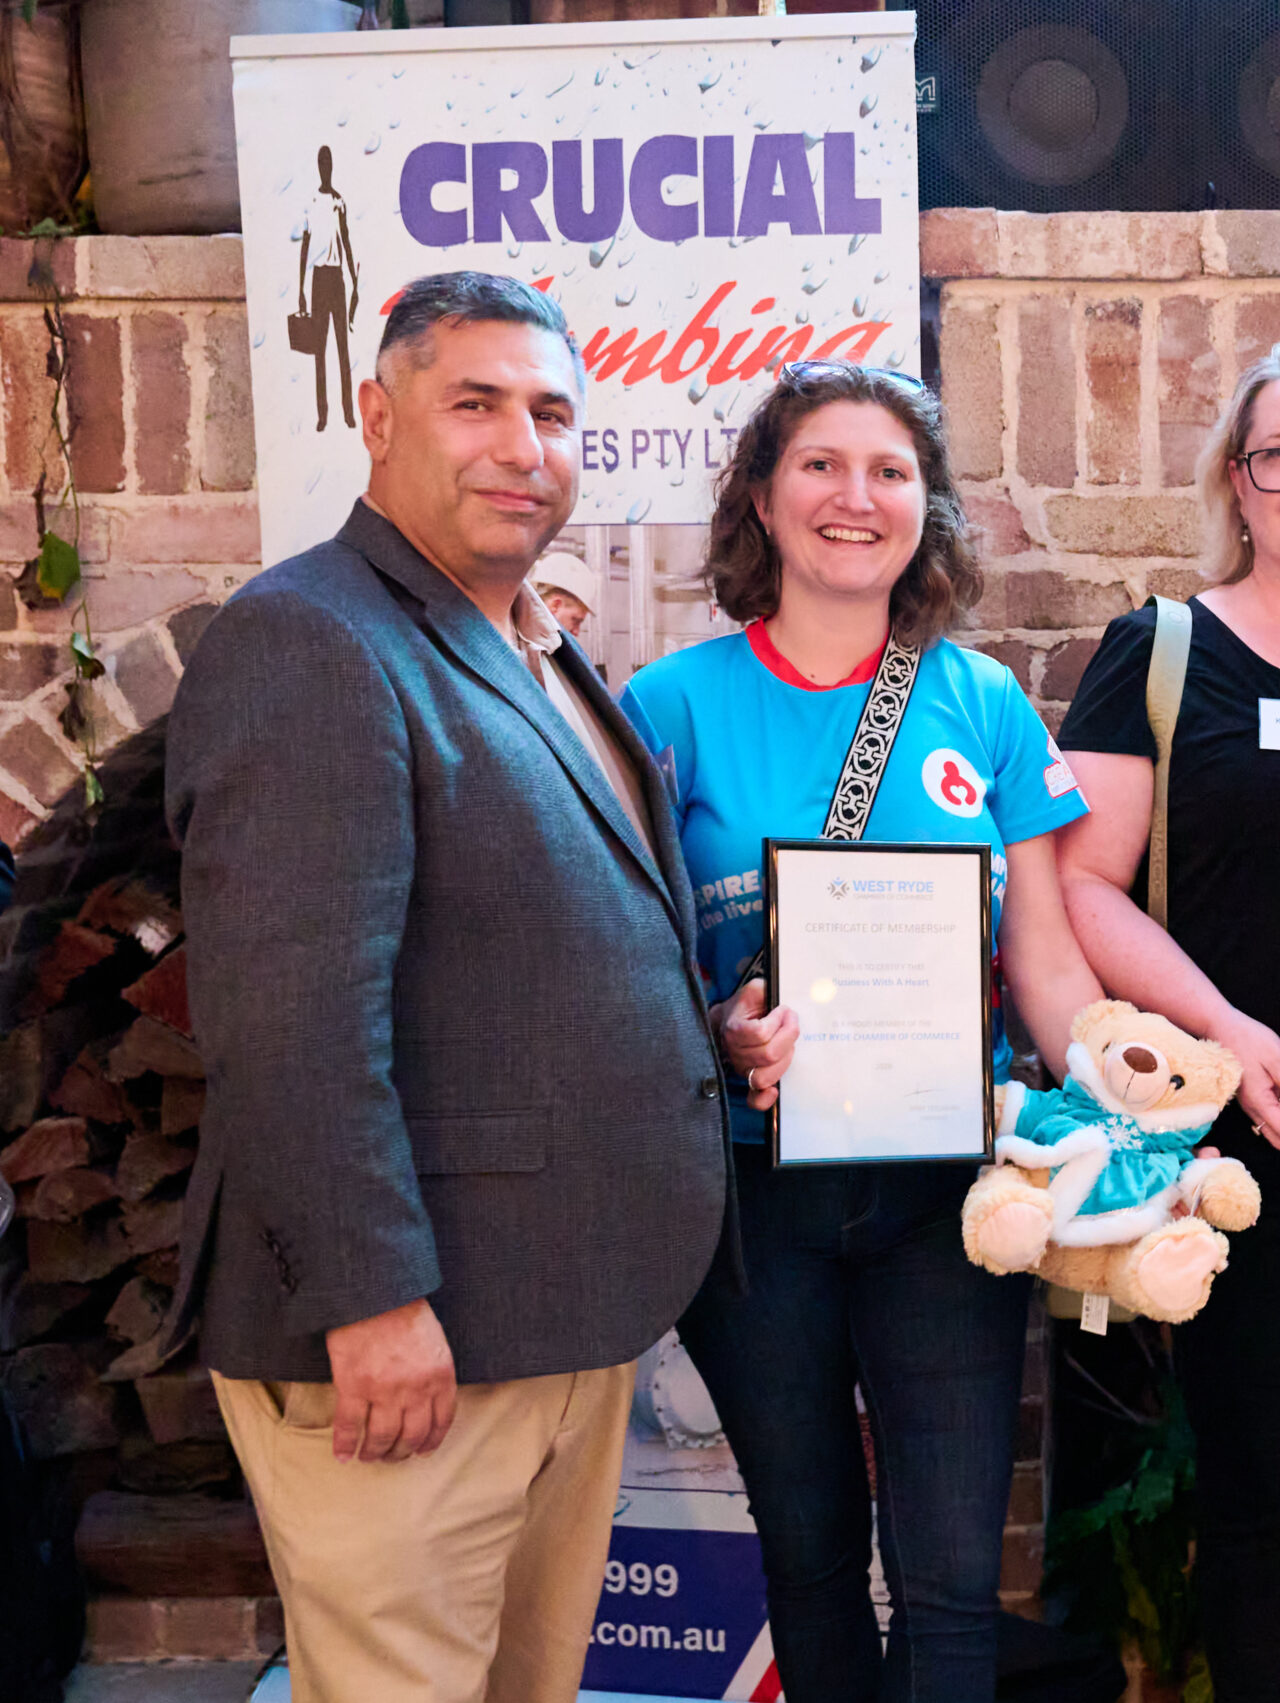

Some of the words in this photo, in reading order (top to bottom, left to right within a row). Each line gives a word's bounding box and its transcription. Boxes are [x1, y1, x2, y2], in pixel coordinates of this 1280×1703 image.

[399, 131, 883, 248] CRUCIAL
[582, 428, 619, 473] ES
[631, 428, 692, 470] PTY
[704, 428, 738, 469] LT
[853, 880, 894, 893] WEST
[898, 880, 935, 893] RYDE
[804, 922, 868, 933] CERTIFICATE
[871, 923, 884, 933] OF
[888, 923, 957, 934] MEMBERSHIP
[905, 977, 930, 987] Heart
[804, 1032, 827, 1041] WEST
[829, 1032, 850, 1041] RYDE
[853, 1032, 896, 1041] CHAMBER
[898, 1032, 909, 1041] OF
[911, 1031, 961, 1041] COMMERCE
[589, 1621, 726, 1653] .com.au
